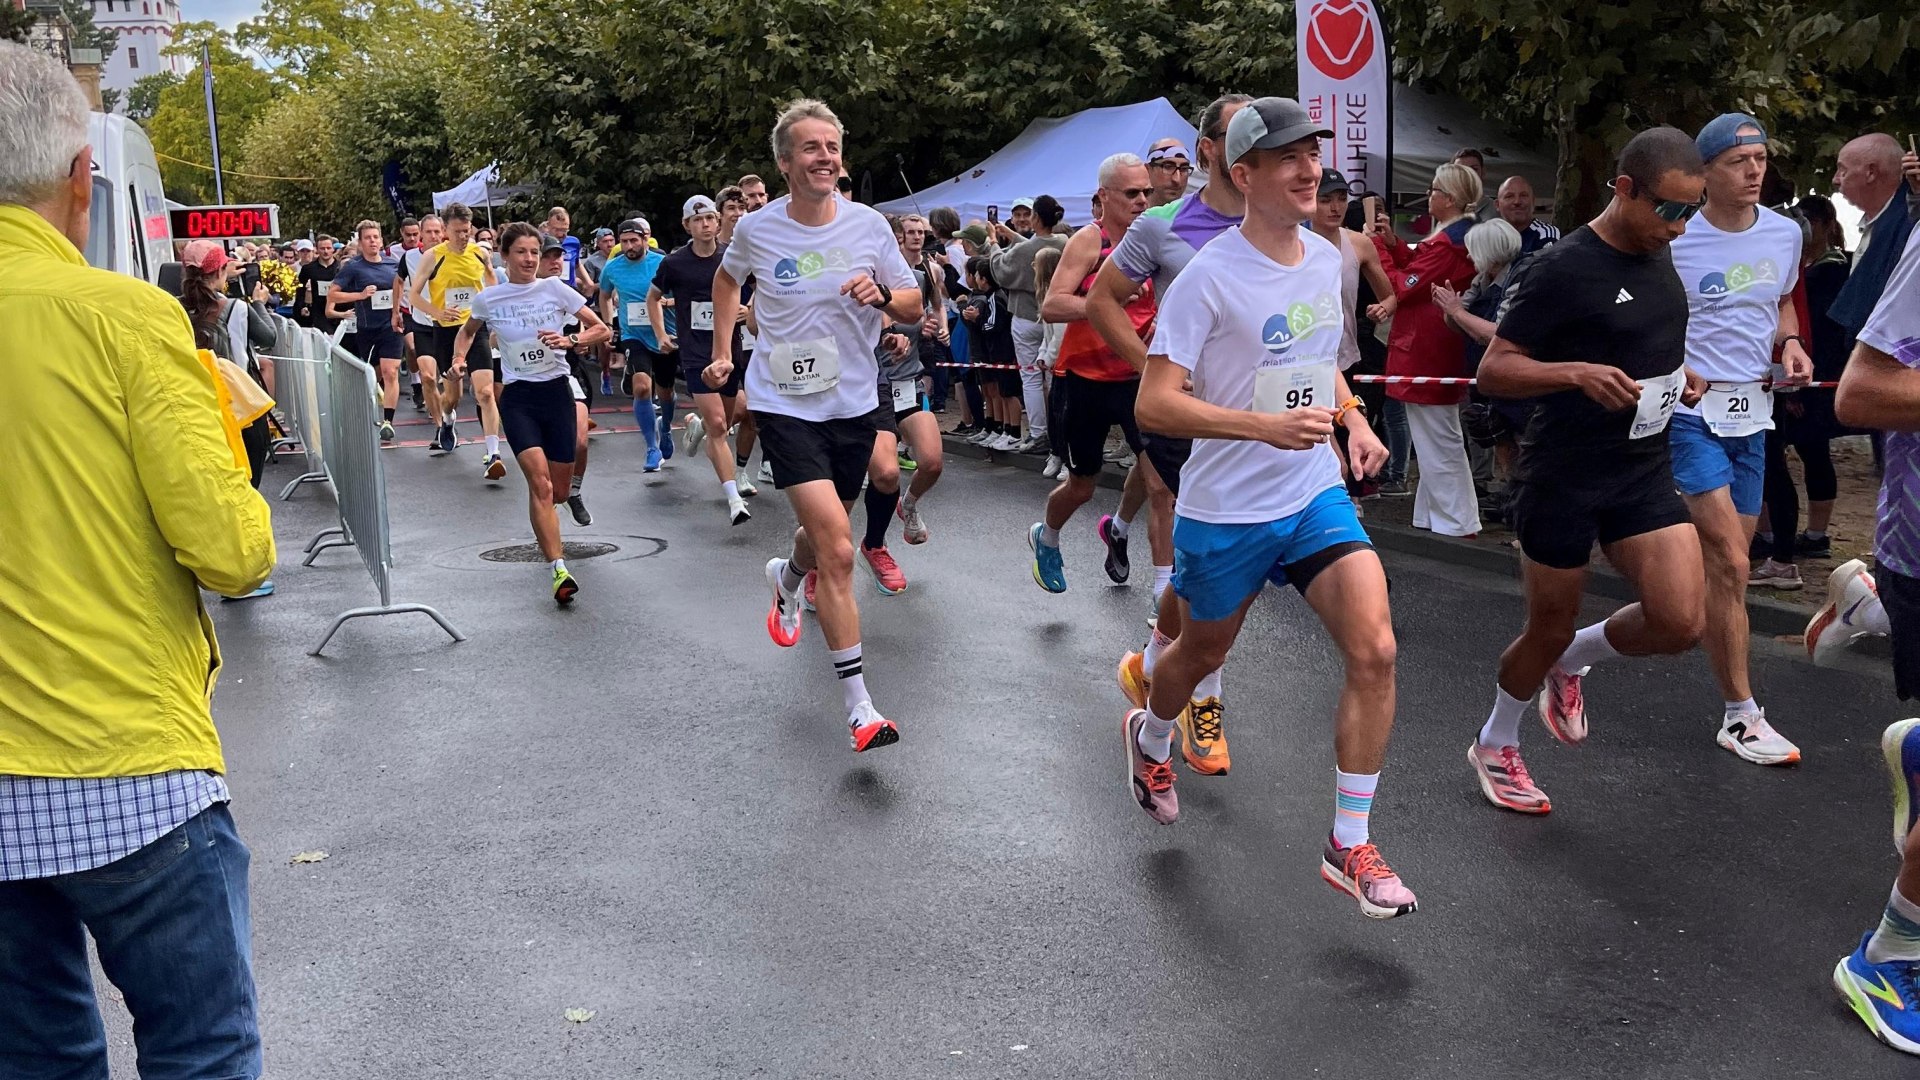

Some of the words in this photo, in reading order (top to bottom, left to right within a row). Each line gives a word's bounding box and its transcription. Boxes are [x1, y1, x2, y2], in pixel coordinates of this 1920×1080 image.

[1346, 93, 1367, 197] OTHEKE
[188, 211, 268, 236] 0:00:04
[454, 292, 470, 301] 102
[776, 288, 806, 296] Triathlon
[520, 349, 545, 362] 169
[792, 358, 816, 375] 67
[793, 373, 820, 381] BASTIAN
[893, 388, 901, 397] 6
[1286, 387, 1313, 409] 95
[1660, 386, 1678, 410] 25
[1727, 397, 1749, 412] 20
